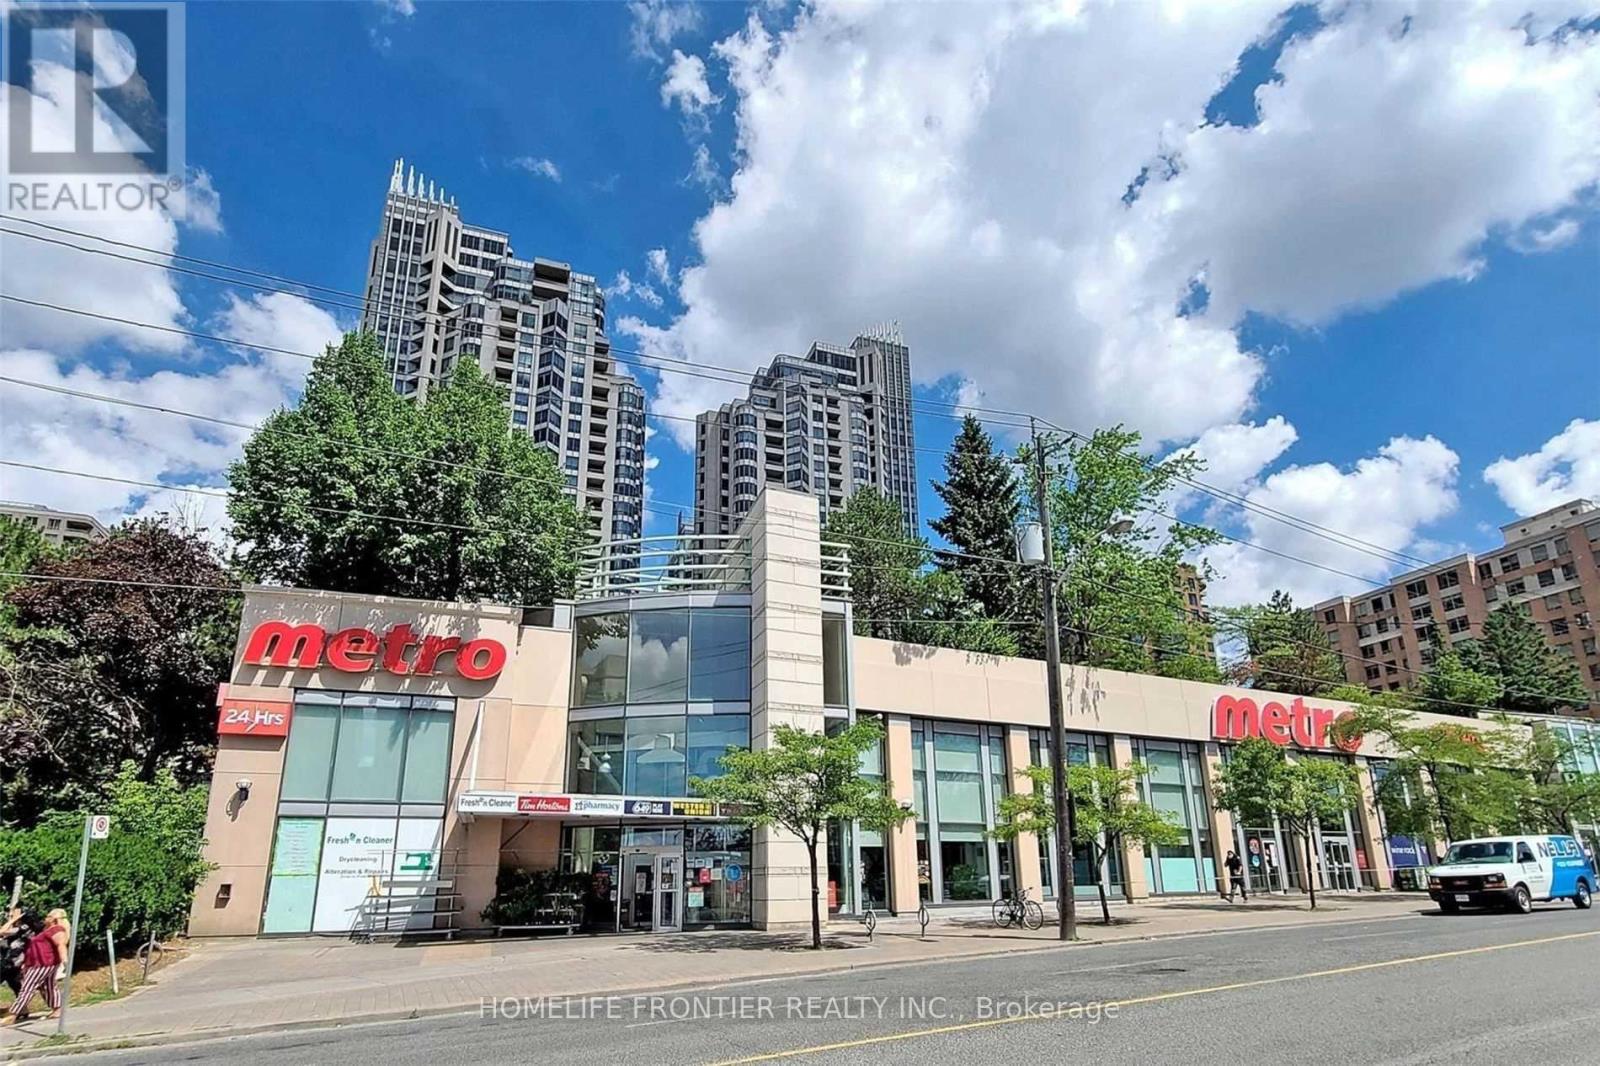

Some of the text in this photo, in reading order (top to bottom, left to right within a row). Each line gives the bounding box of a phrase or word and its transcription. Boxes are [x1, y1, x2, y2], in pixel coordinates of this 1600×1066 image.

[242, 620, 508, 681] metro
[1212, 694, 1364, 752] metro
[520, 799, 569, 811] Tim Hortons
[583, 802, 620, 812] pharmacy
[327, 836, 350, 844] Fresh
[363, 836, 393, 844] Cleaner
